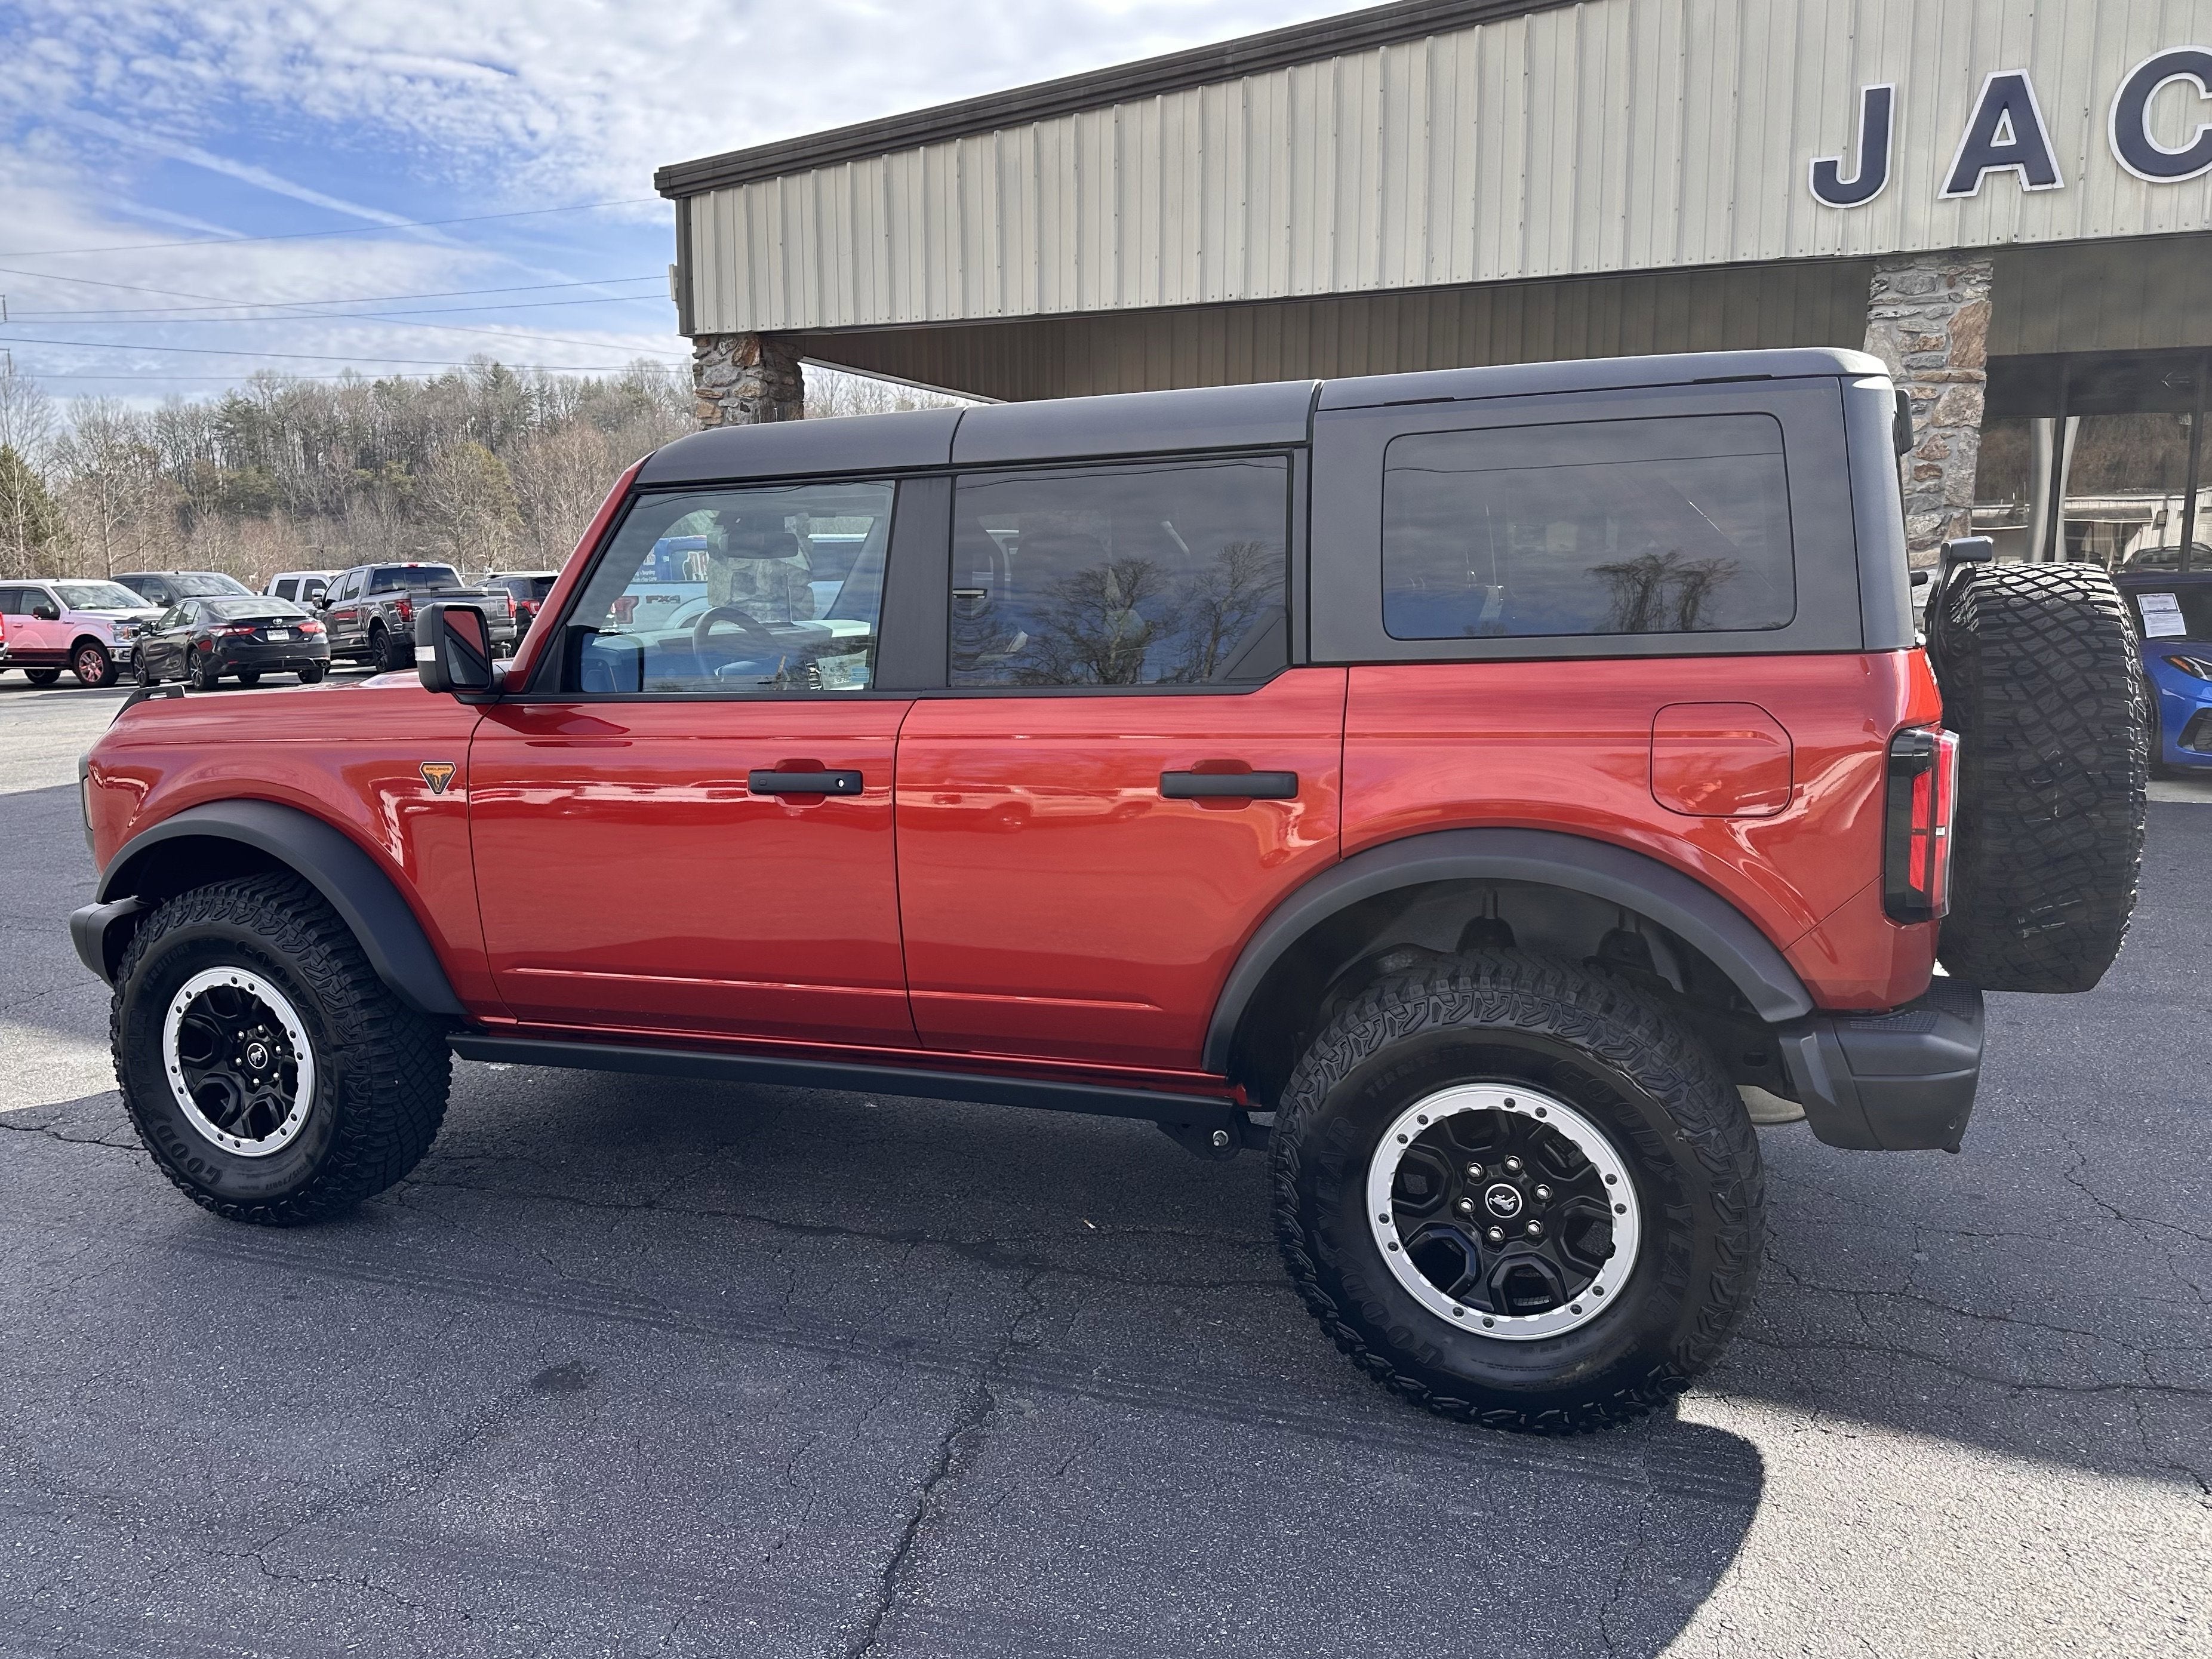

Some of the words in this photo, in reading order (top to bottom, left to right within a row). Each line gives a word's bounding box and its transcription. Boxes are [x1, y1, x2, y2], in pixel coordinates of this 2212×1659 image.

[1808, 45, 2212, 209] JAC
[645, 595, 681, 604] FX4
[1312, 1116, 1446, 1369] GOODYEAR
[1552, 1060, 1695, 1325] GOODYEAR
